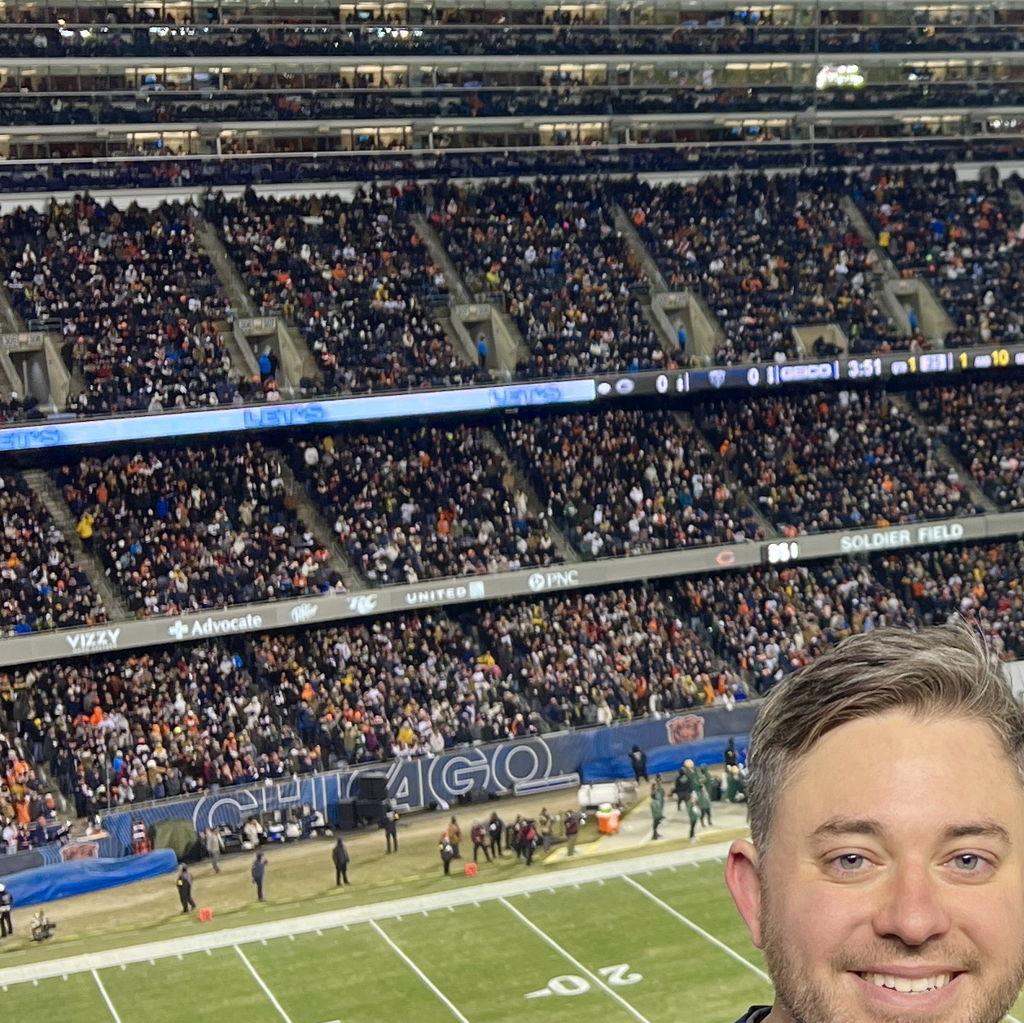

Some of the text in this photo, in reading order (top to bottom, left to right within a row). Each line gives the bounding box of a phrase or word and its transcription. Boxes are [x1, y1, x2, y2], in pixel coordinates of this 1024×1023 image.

[992, 348, 1010, 367] 10
[840, 523, 964, 552] SOLDIER FIELD
[546, 570, 579, 587] PNC
[406, 586, 467, 604] UNITED
[191, 613, 263, 637] Advocate
[66, 628, 121, 649] VIZZY
